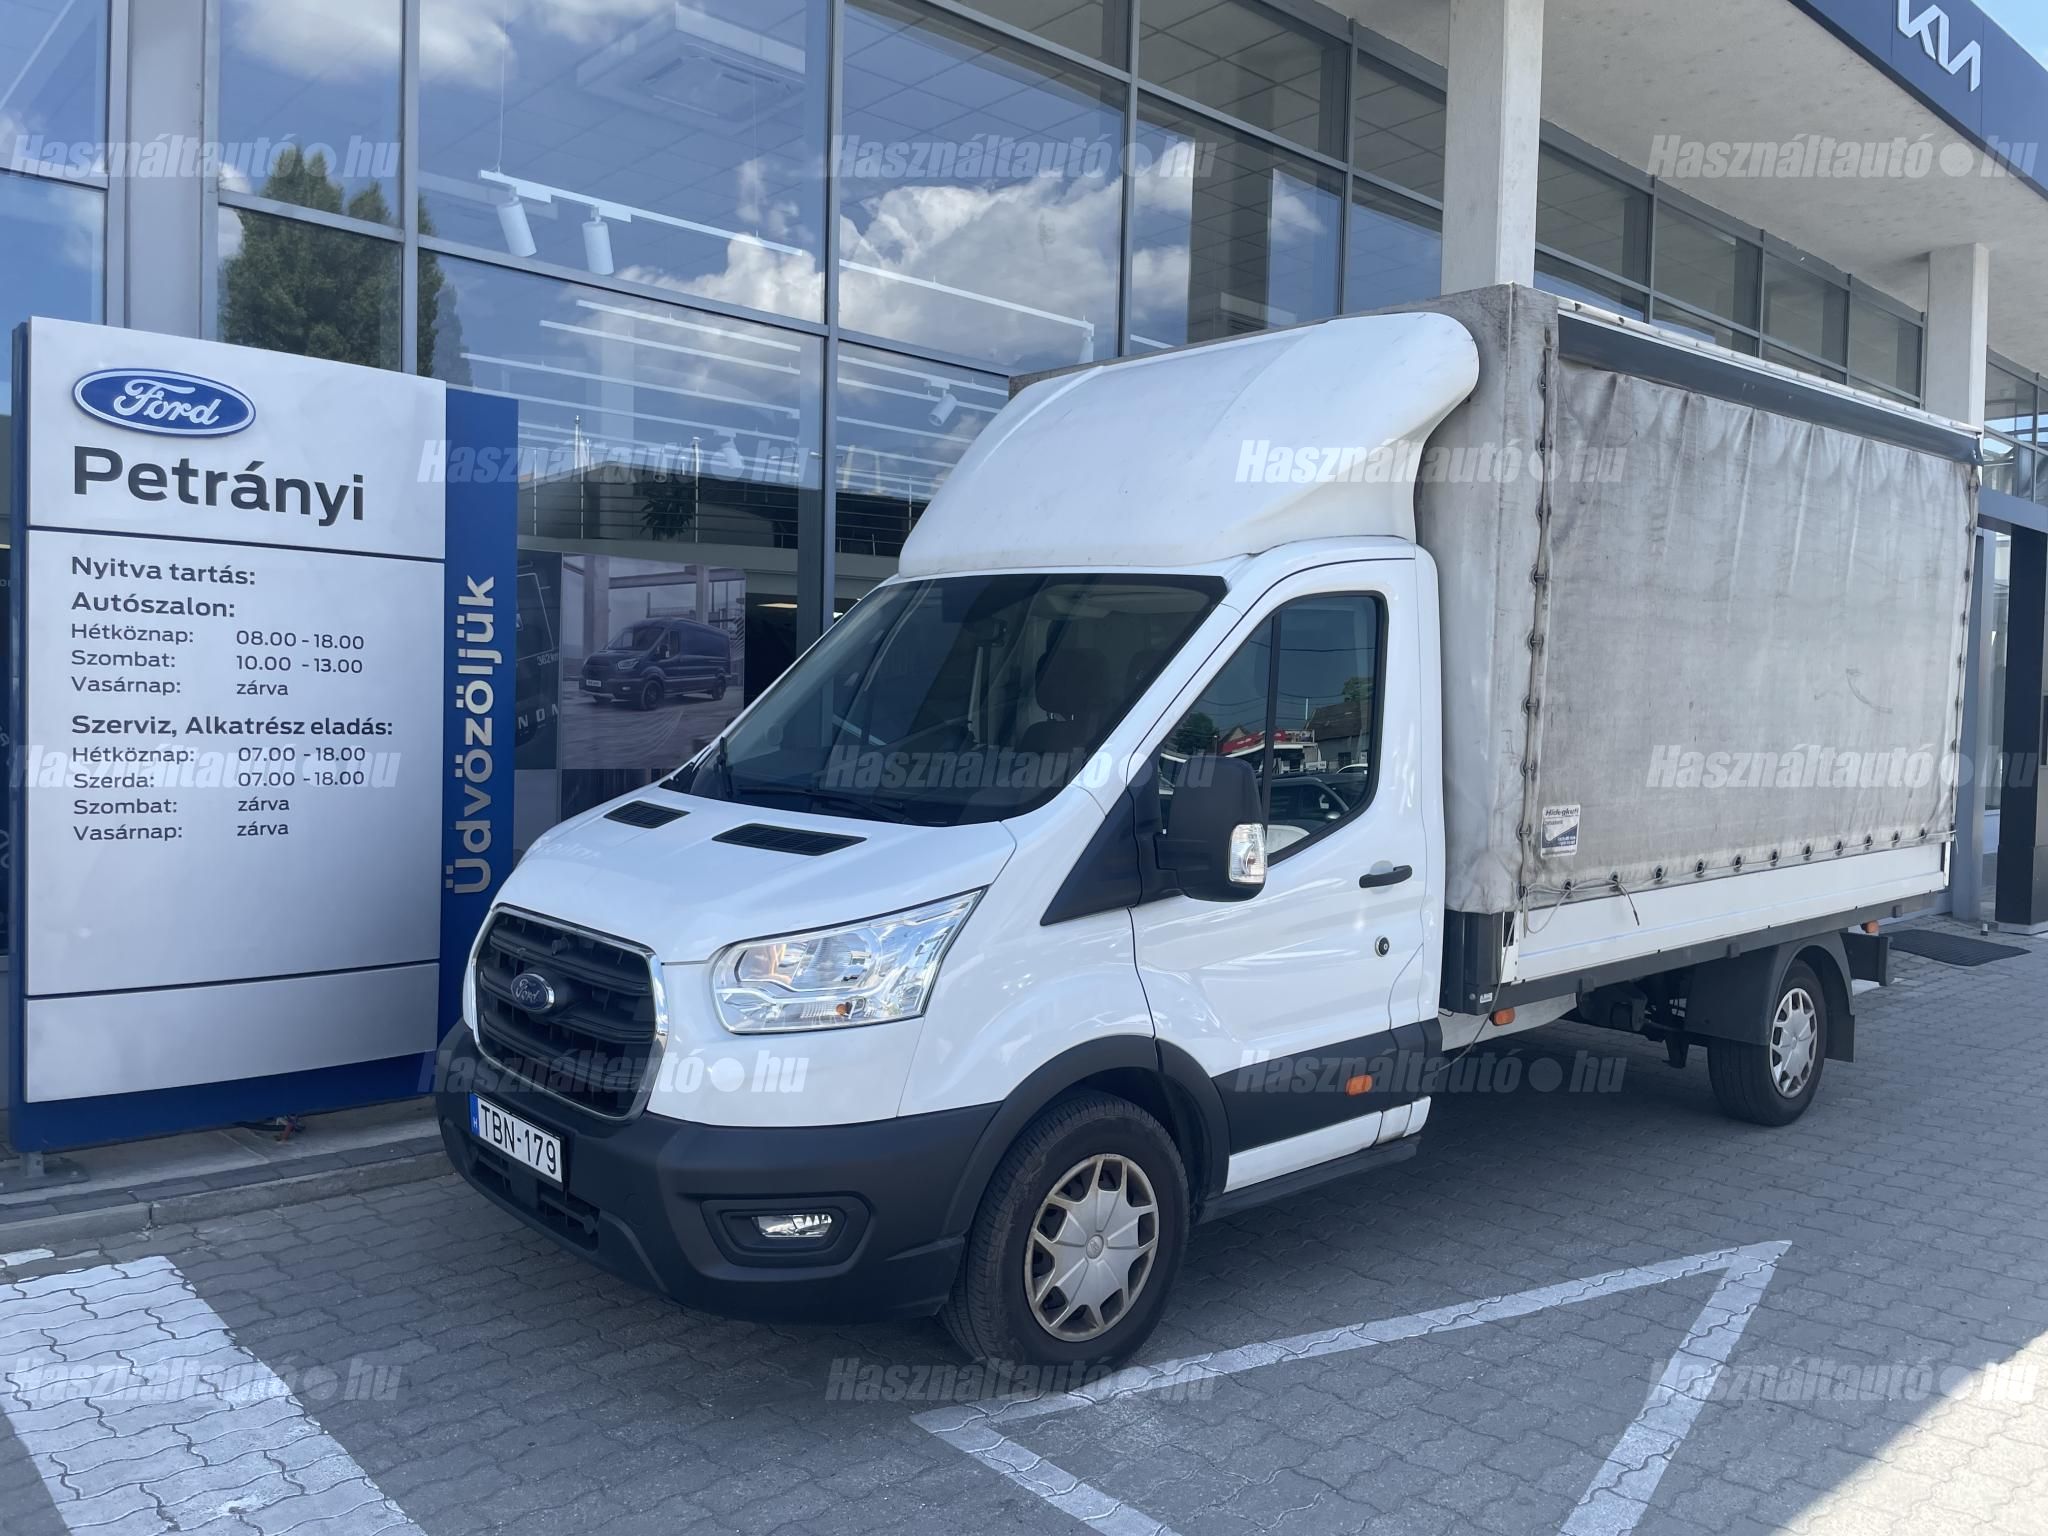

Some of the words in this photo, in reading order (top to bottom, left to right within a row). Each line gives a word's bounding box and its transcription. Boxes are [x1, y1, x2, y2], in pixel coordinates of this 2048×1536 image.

[114, 378, 221, 426] Ford
[73, 445, 364, 527] Petrányi
[71, 556, 162, 580] Nyitva
[168, 563, 255, 585] tartás:
[71, 591, 235, 618] Autószalon:
[71, 623, 194, 646] Hétköznap:
[236, 630, 297, 647] 08.00
[71, 649, 175, 668] Szombat:
[236, 655, 291, 672] 10.00
[71, 676, 181, 696] Vasárnap:
[236, 680, 289, 696] zárva
[71, 715, 177, 738] Szerviz,
[185, 716, 305, 735] Alkatrész
[310, 717, 393, 736] eladás:
[445, 575, 503, 895] Üdvözöljük
[72, 746, 194, 765] Hétköznap:
[238, 747, 296, 762] 07.00
[73, 772, 154, 789] Szerda:
[238, 771, 296, 787] 07.00
[73, 798, 177, 815] Szombat:
[238, 796, 290, 812] zárva
[73, 823, 182, 842] Vasárnap:
[237, 820, 289, 837] zárva
[515, 978, 540, 1004] Ford
[481, 1104, 557, 1175] TBN-179
